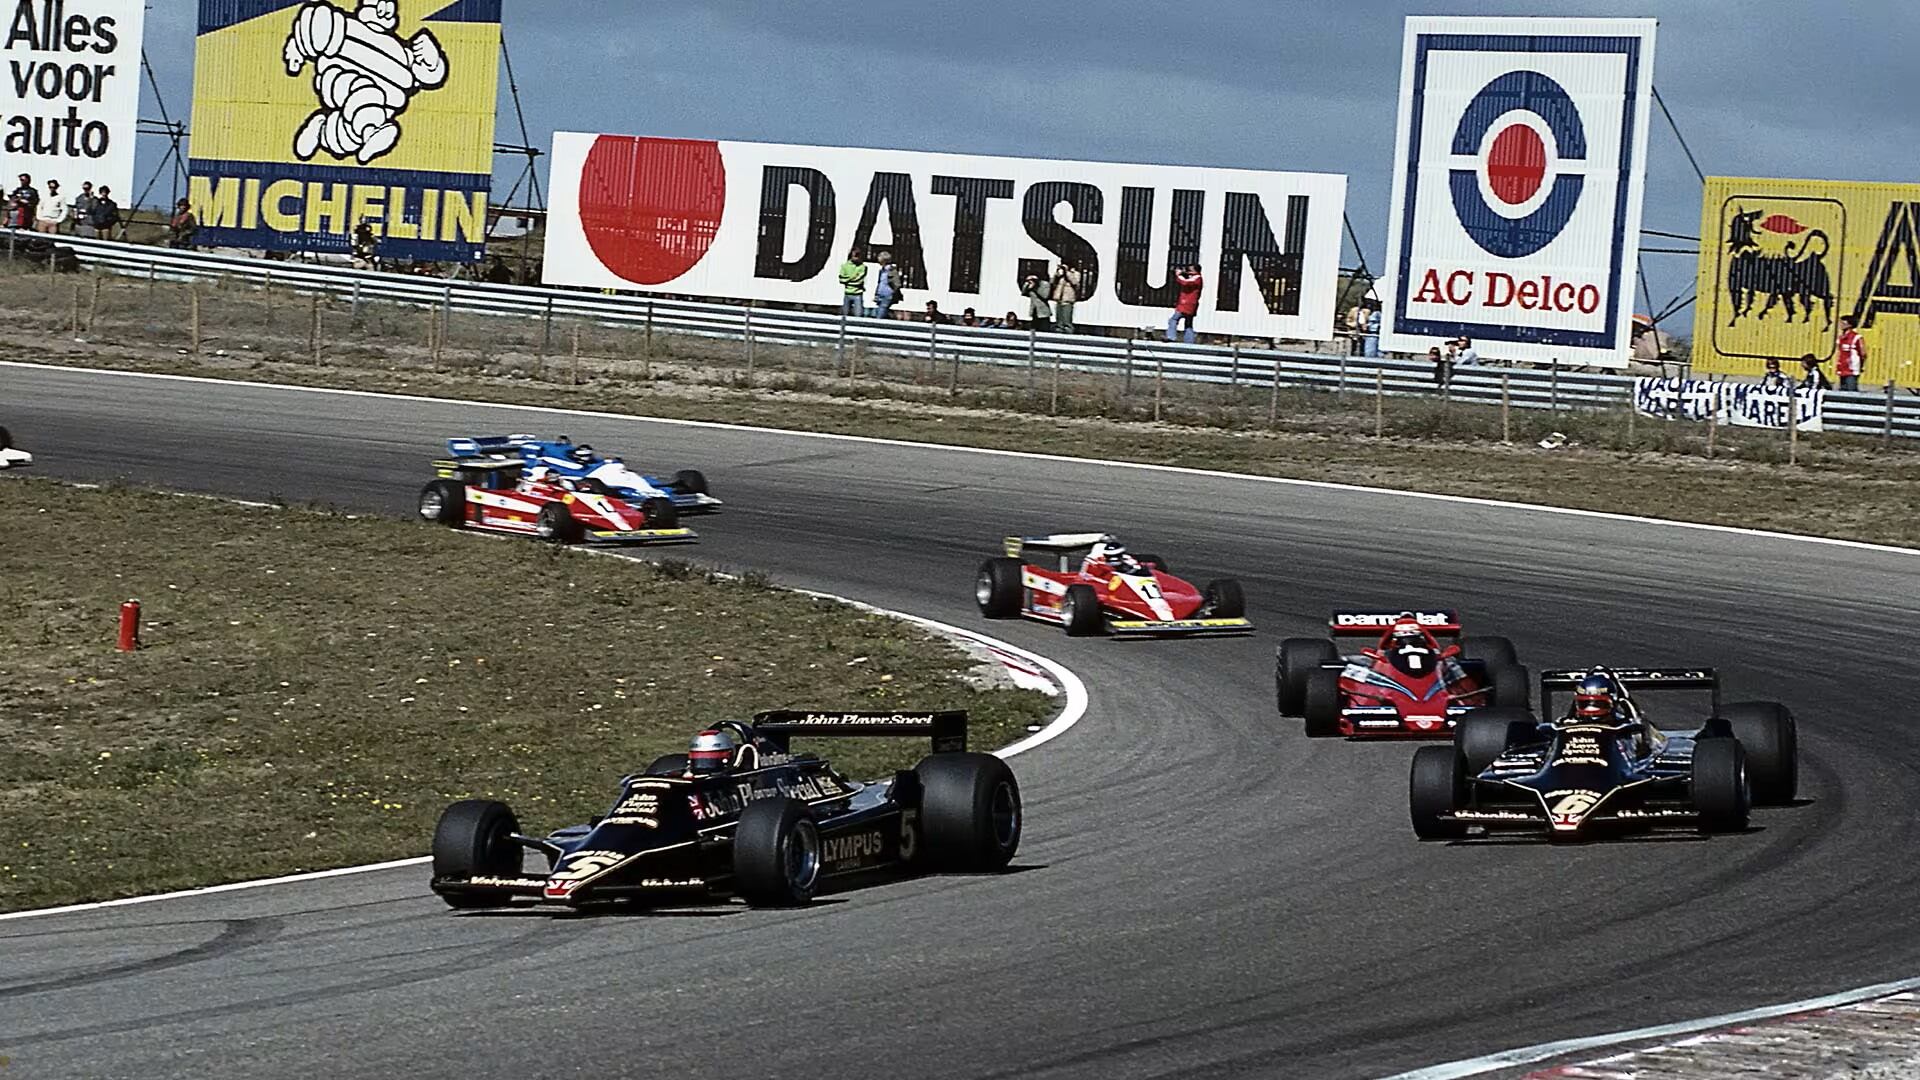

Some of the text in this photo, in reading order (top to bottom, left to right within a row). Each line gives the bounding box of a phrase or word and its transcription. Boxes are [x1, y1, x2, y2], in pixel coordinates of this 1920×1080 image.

[4, 0, 118, 54] Alles
[9, 60, 116, 103] voor
[4, 105, 110, 159] auto
[188, 175, 489, 244] MICHELIN
[754, 164, 1310, 317] DATSUN
[1412, 268, 1601, 314] AC Delco
[1733, 396, 1819, 427] MARELI
[1337, 612, 1448, 625] parmlat
[1407, 655, 1422, 669] 1
[799, 714, 839, 724] John
[1551, 794, 1598, 815] 6
[824, 832, 881, 862] LYMPUS
[900, 808, 915, 857] 5
[550, 856, 619, 880] 5
